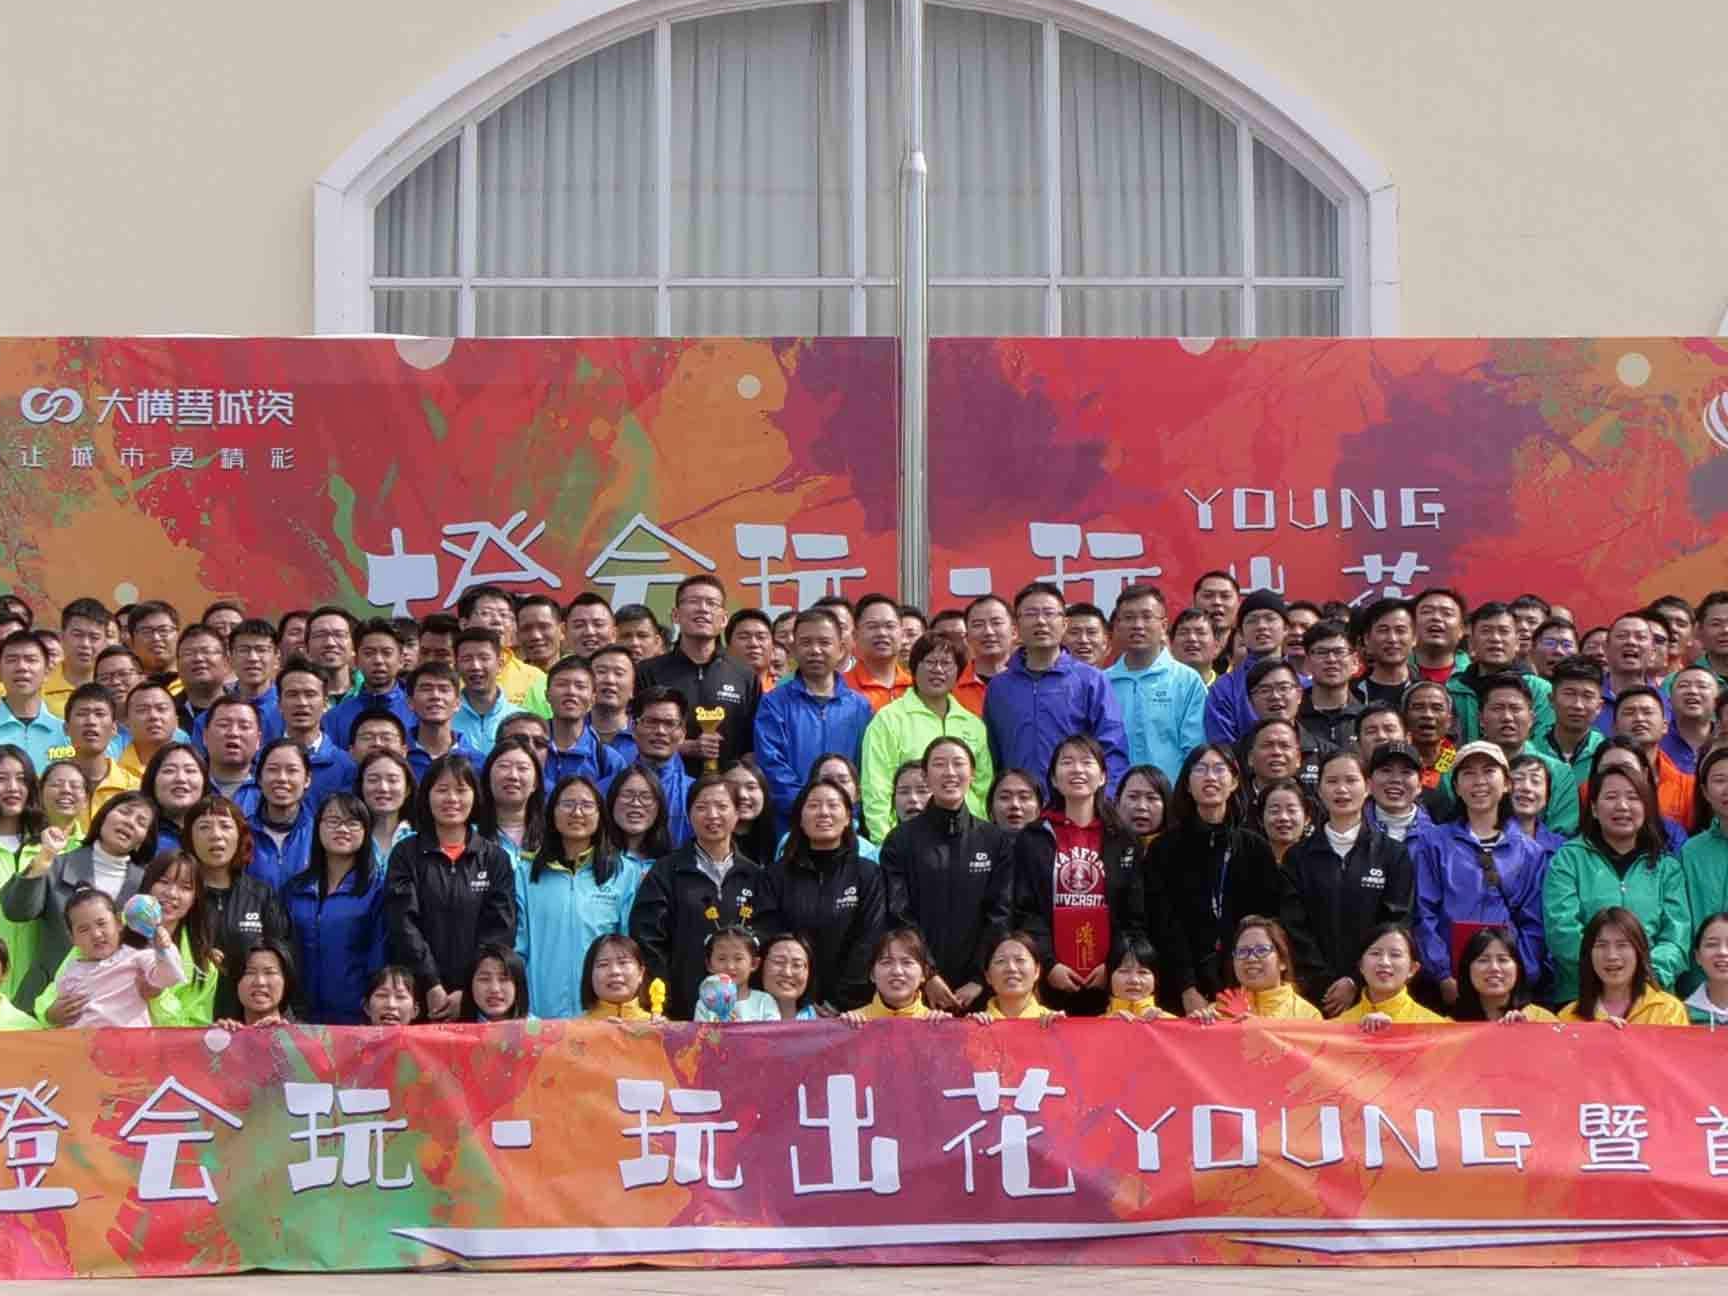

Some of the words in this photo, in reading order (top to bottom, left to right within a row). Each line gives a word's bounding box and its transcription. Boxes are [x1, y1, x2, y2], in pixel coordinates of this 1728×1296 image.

[97, 389, 295, 427] 大横琴城资
[20, 447, 297, 470] 让城市更精彩
[1184, 488, 1445, 529] YOUNG
[1115, 1105, 1532, 1171] YOUNG
